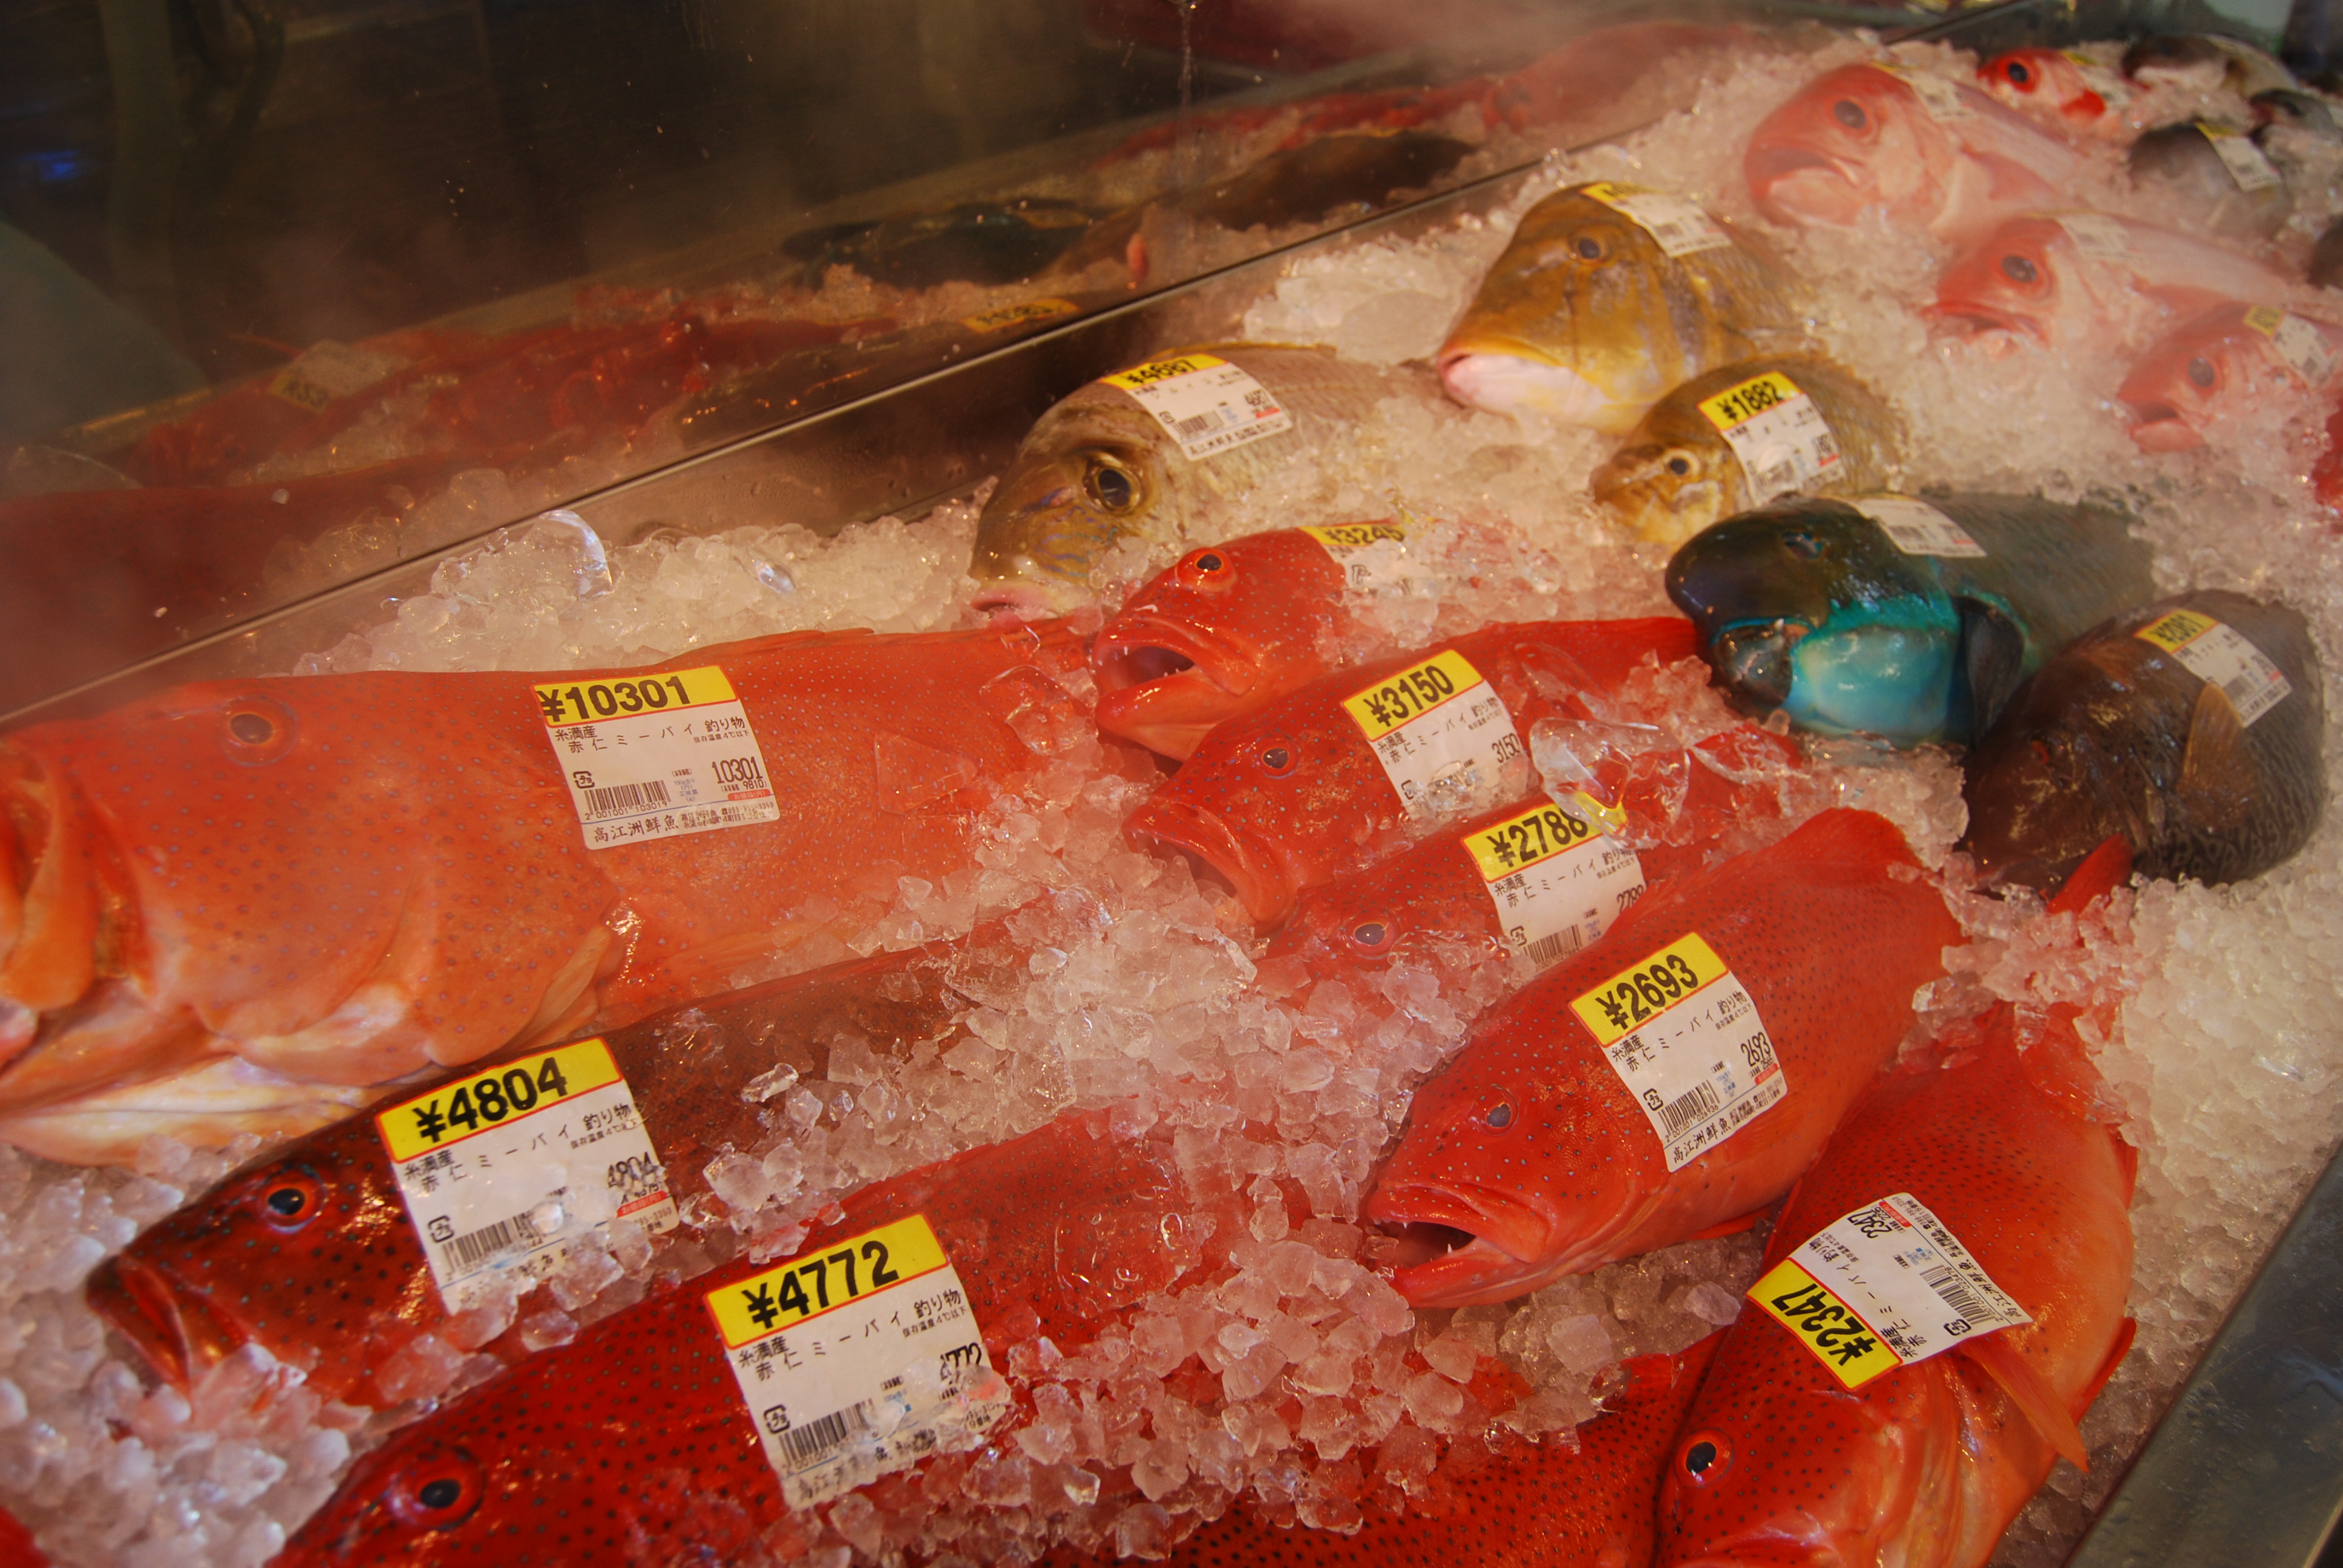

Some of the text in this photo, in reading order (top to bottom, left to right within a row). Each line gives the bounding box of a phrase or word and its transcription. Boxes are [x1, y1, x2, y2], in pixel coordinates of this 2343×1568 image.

[537, 676, 690, 722] ¥10301
[1363, 665, 1454, 727] ¥3150
[555, 725, 598, 742] 糸満産
[705, 716, 745, 733] 釣り物
[1378, 731, 1406, 754] 糸満産
[1492, 733, 1521, 763] 3150
[712, 756, 763, 784] 10301
[594, 814, 679, 843] 高江洲鮮魚
[1486, 808, 1588, 867] ¥2788
[1495, 873, 1527, 897] 糸満産
[1595, 954, 1699, 1030] ¥2693
[1717, 990, 1747, 1016] 釣り物
[1612, 1034, 1644, 1063] 糸満産
[1741, 1031, 1772, 1067] 2693
[412, 1057, 568, 1143] ¥4804
[583, 1103, 632, 1132] 釣り物
[1673, 1117, 1731, 1163] 高江洲鮮魚
[404, 1149, 454, 1180] 糸満産
[1847, 1210, 1892, 1239] 2347
[1809, 1236, 1839, 1263] 釣り物
[741, 1240, 899, 1329] ¥4772
[1959, 1259, 2022, 1319] 高江洲鮮魚
[914, 1288, 962, 1319] 釣り物
[1771, 1283, 1877, 1367] ¥2347
[1879, 1318, 1919, 1357] 糸満産
[738, 1336, 789, 1369] 糸満産
